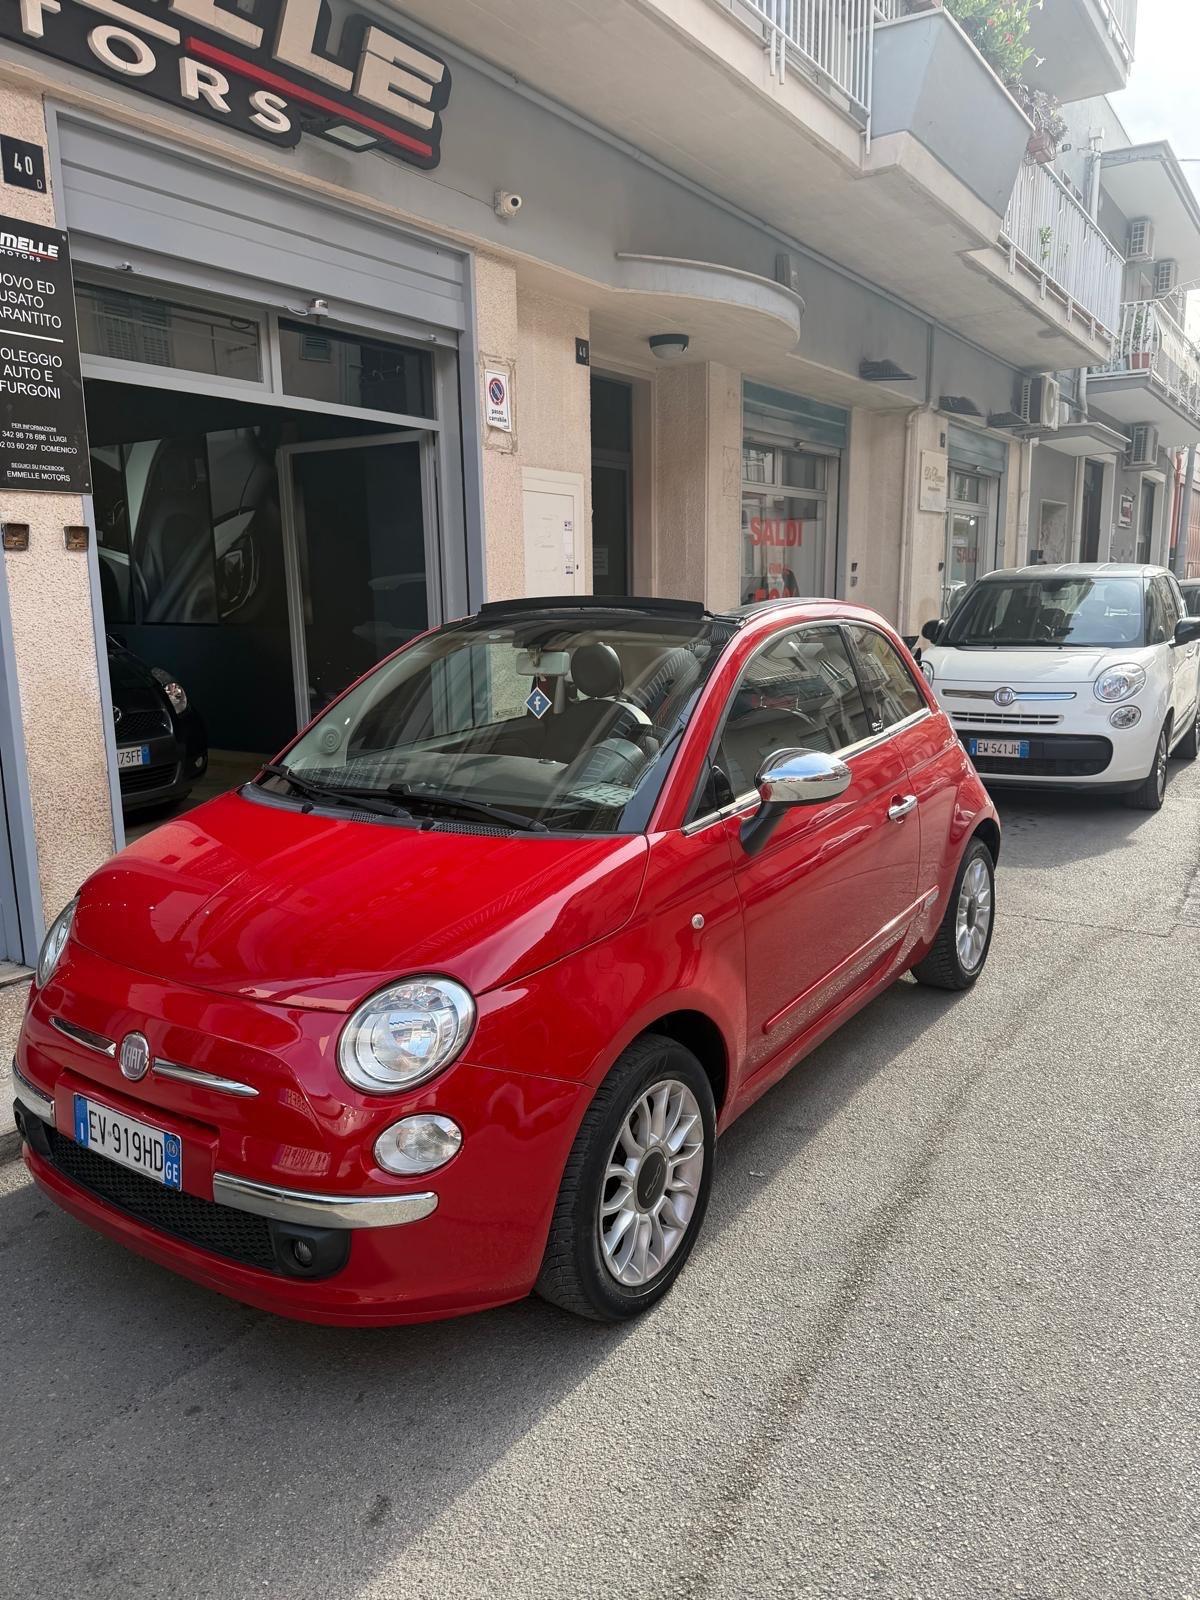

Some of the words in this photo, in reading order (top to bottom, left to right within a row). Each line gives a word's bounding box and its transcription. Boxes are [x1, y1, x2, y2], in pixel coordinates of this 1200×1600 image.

[14, 152, 34, 176] 40
[36, 178, 43, 190] D
[0, 248, 41, 262] MOTORS
[0, 272, 34, 291] OVO
[37, 280, 55, 294] ED
[0, 289, 44, 309] USATO
[0, 347, 63, 368] OLEGGIO
[3, 364, 41, 380] AUTO
[44, 370, 54, 383] E
[0, 379, 61, 400] FURGONI
[2, 430, 14, 438] 342
[15, 431, 24, 439] 98
[25, 432, 33, 440] 78
[49, 435, 67, 443] LUIGI
[16, 442, 25, 450] 60
[25, 443, 38, 451] 297
[40, 444, 78, 454] DOMENICO
[7, 471, 40, 479] EMMELLE
[41, 473, 71, 482] MOTORS
[750, 516, 804, 548] SALDI
[117, 750, 141, 766] 73FF
[125, 1045, 144, 1070] FIAT
[88, 1110, 107, 1147] EV
[111, 1122, 164, 1173] 919HD
[165, 1160, 179, 1183] GE
